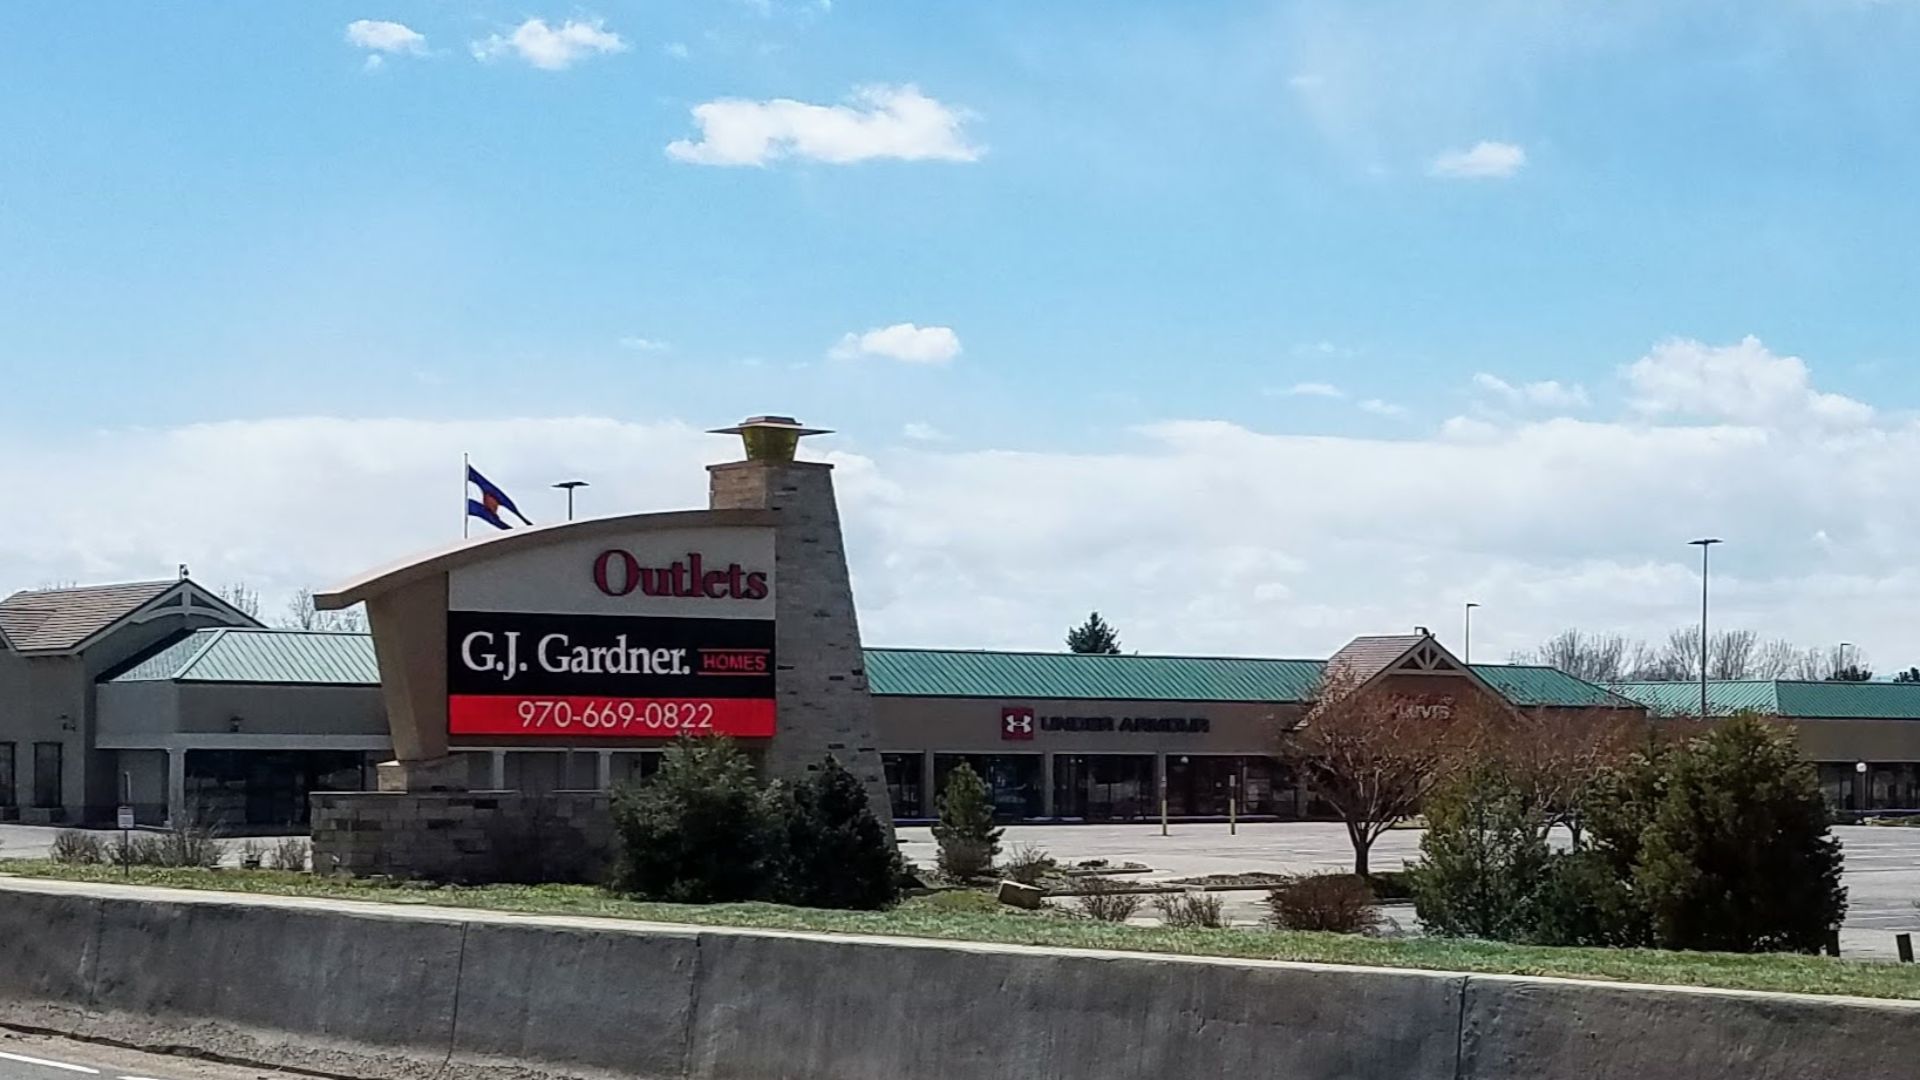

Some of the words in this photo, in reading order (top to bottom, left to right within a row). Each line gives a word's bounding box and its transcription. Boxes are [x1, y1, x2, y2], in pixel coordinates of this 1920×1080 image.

[593, 548, 769, 600] Outlets
[461, 630, 528, 681] G.J.
[537, 633, 692, 676] Gardner.
[702, 653, 767, 671] HOMES
[517, 699, 714, 729] 970-669-0822
[1040, 716, 1115, 732] UNDER
[1118, 717, 1211, 733] ARMOUR
